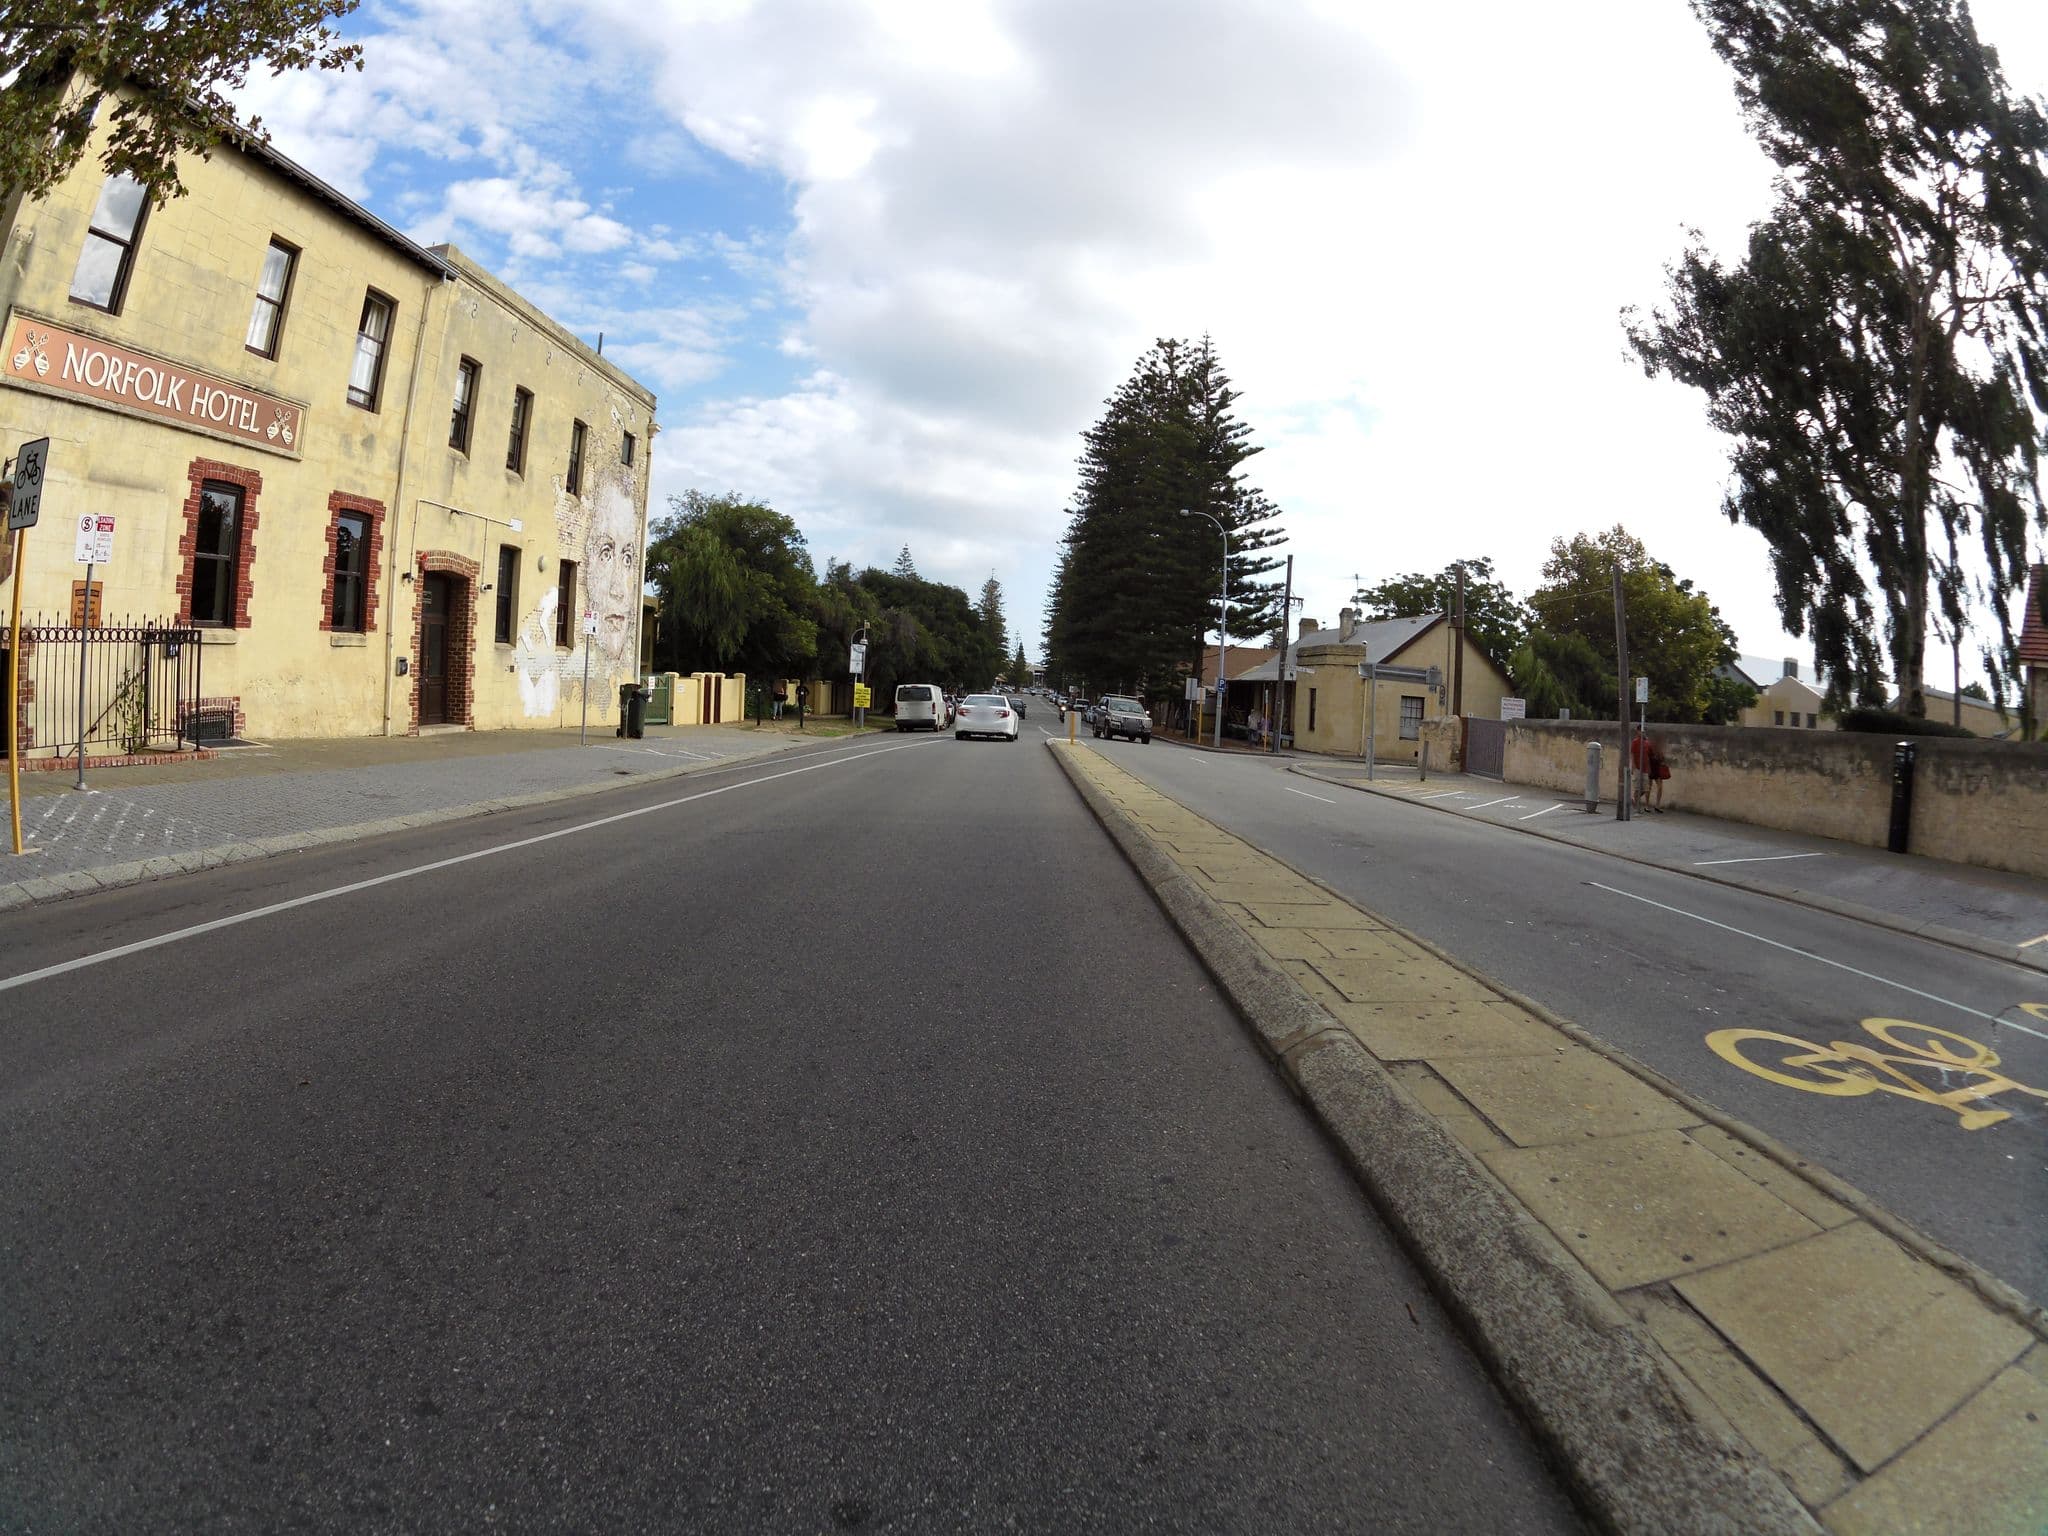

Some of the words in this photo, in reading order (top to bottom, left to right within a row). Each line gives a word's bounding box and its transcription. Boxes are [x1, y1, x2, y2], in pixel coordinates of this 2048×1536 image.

[62, 342, 186, 411] NORFOLK
[190, 383, 260, 434] HOTEL
[12, 495, 38, 519] LANE
